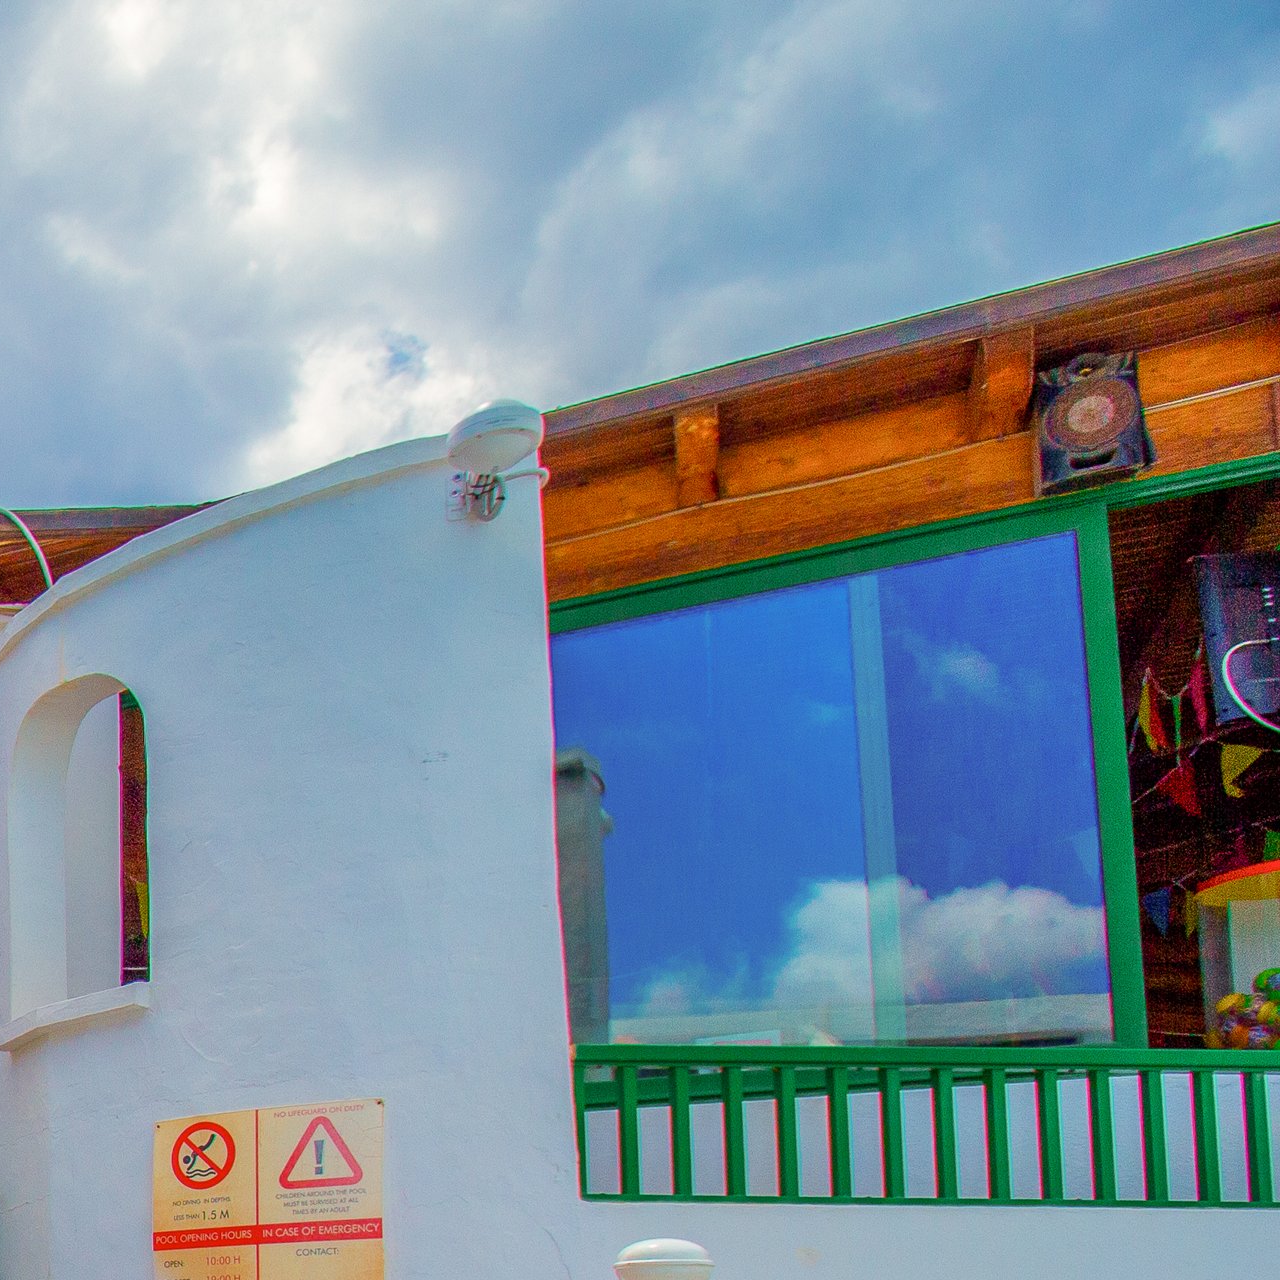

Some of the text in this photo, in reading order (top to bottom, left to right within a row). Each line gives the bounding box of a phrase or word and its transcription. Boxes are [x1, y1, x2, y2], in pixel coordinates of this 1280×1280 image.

[288, 1107, 328, 1116] LIFEGUARD
[344, 1104, 365, 1112] DUTY
[275, 1191, 305, 1199] CHILDREN
[202, 1210, 216, 1220] 1.5
[220, 1210, 229, 1219] M
[263, 1223, 379, 1237] IN CASE OF EMERGENCY
[155, 1230, 252, 1244] POOL OPENING HOURS
[296, 1248, 339, 1256] CONTACT:
[206, 1256, 240, 1265] 10:00 H
